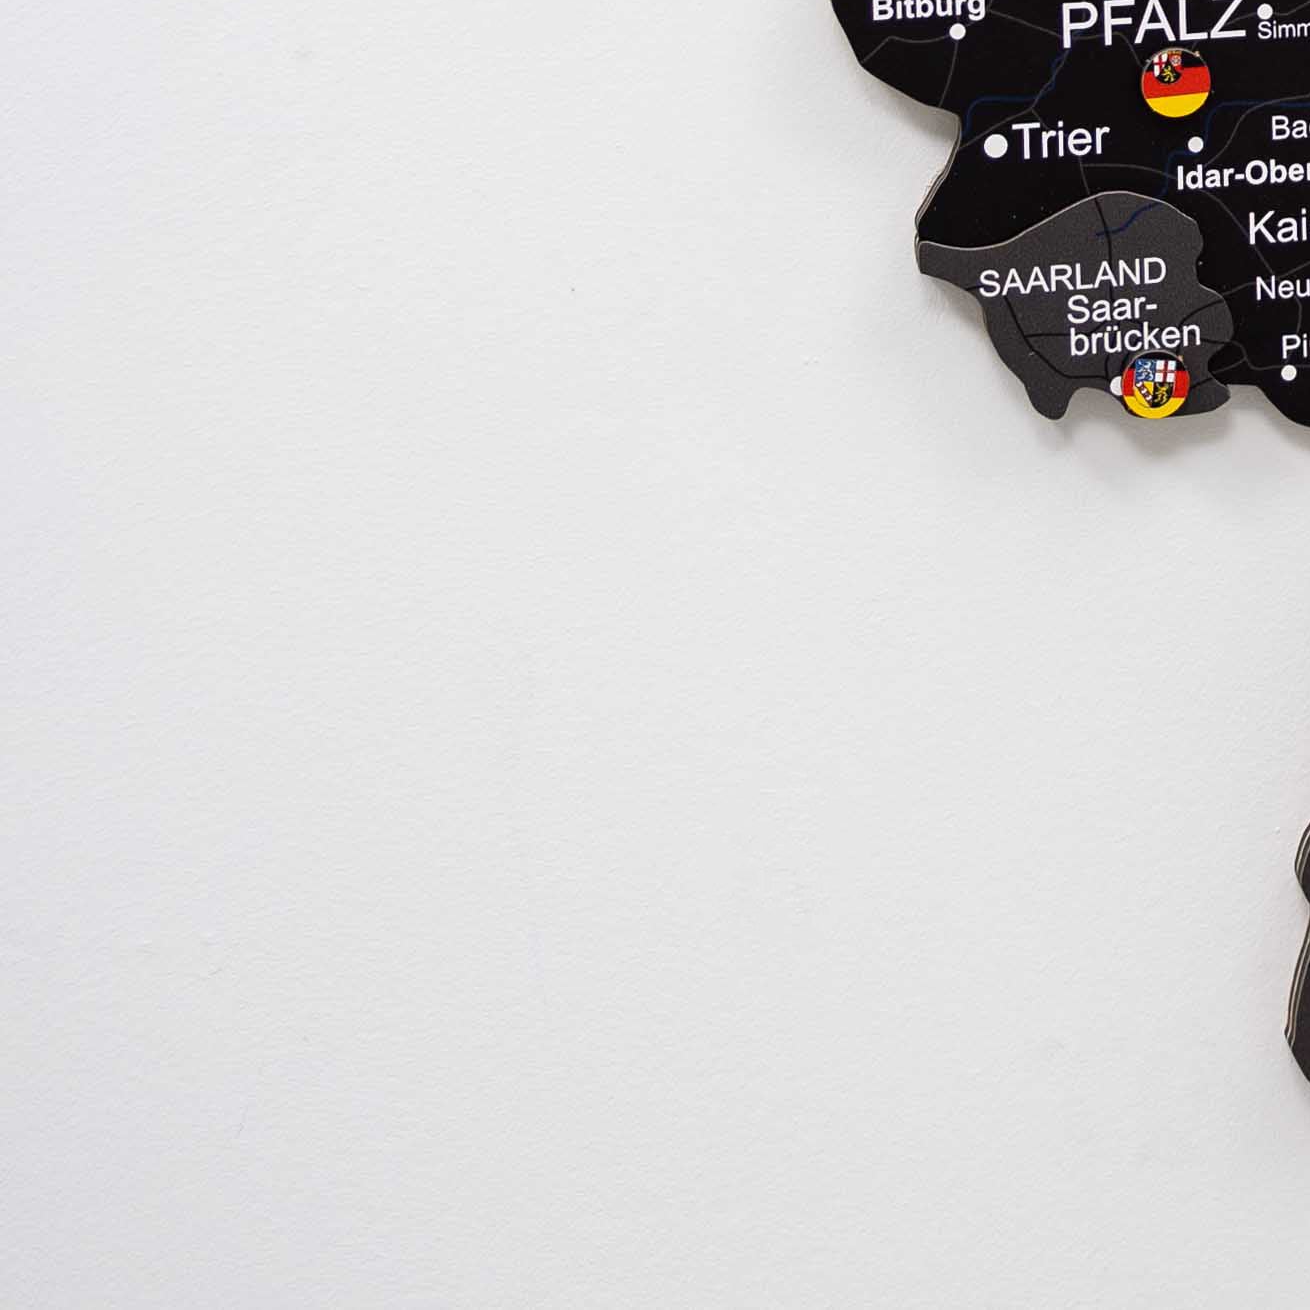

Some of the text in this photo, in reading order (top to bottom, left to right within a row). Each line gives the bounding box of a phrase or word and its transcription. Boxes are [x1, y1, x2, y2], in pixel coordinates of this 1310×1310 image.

[1012, 121, 1110, 159] Trier
[980, 257, 1166, 297] SAARLAND
[1068, 295, 1157, 323] Saar-
[1071, 322, 1200, 355] brücken
